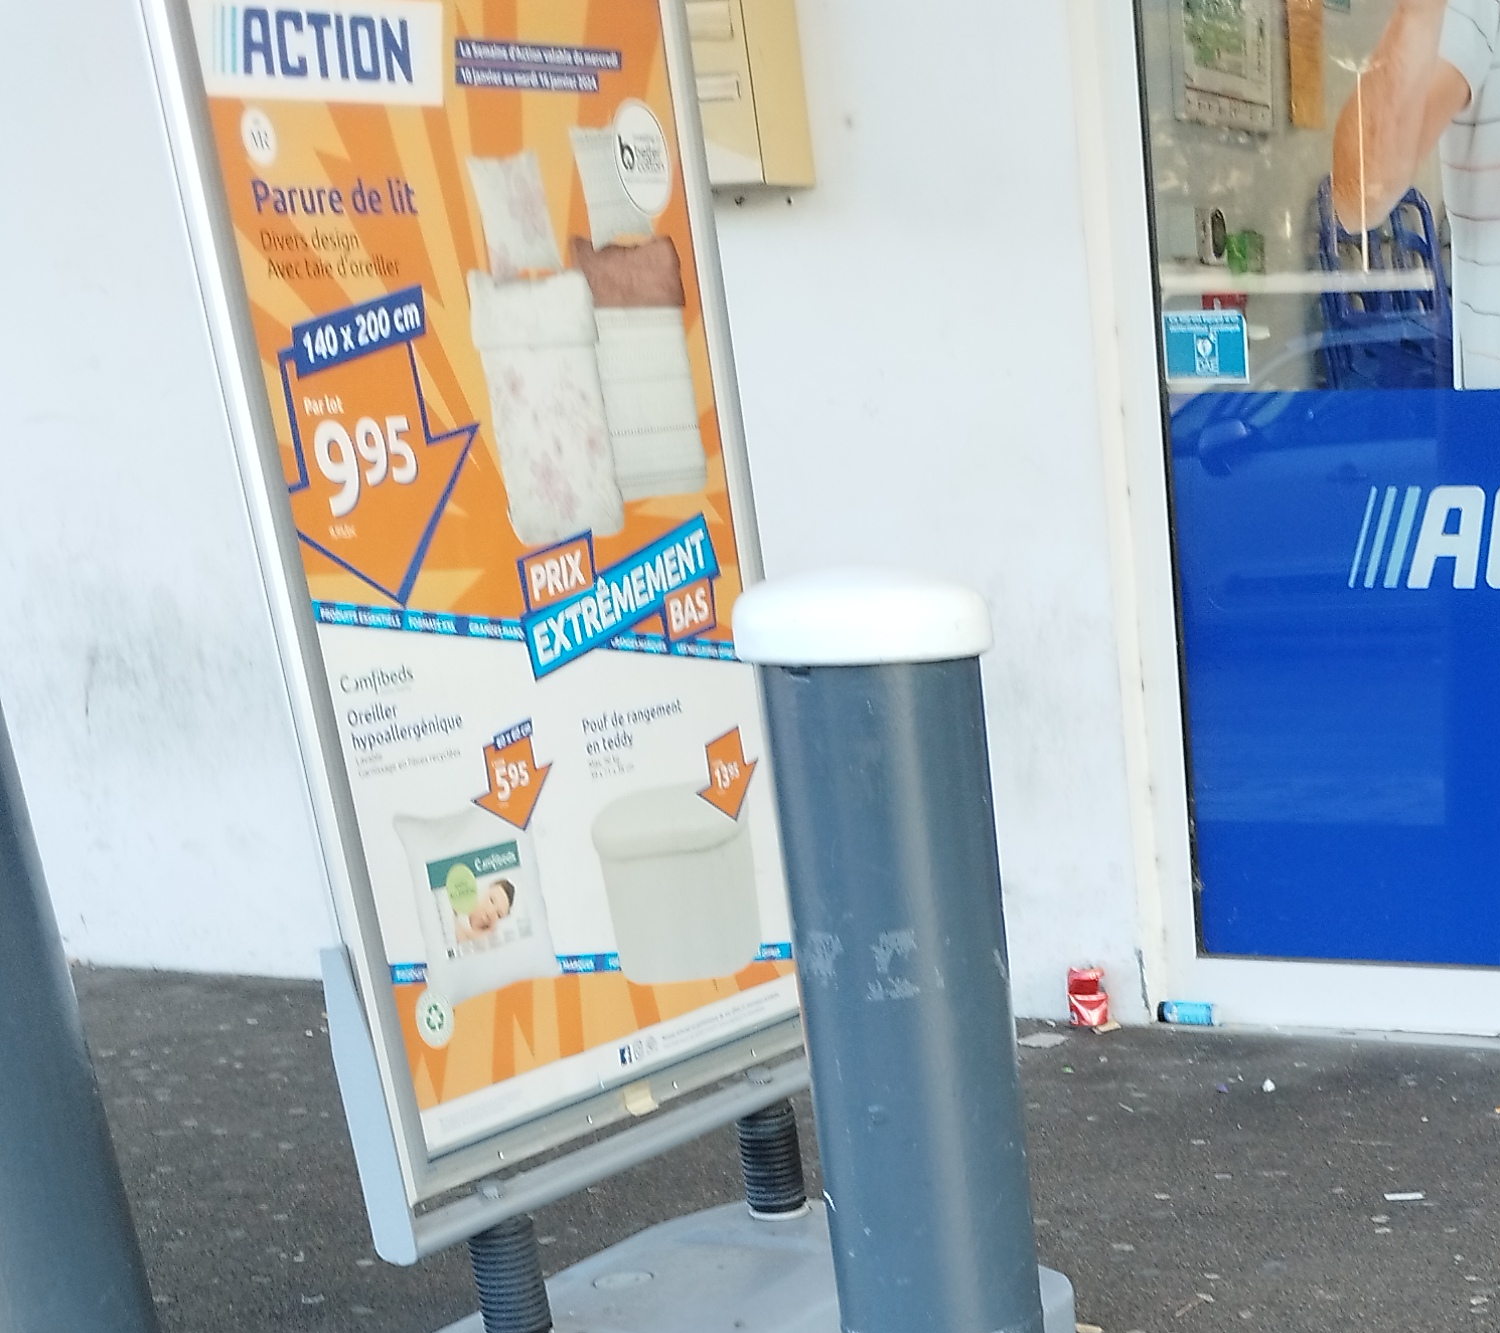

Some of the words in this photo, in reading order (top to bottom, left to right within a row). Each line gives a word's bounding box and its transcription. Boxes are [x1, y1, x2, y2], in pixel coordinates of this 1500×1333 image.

[243, 8, 414, 84] ACTION
[251, 179, 344, 215] Parure
[352, 177, 382, 216] de
[387, 177, 418, 216] lit
[260, 230, 308, 251] Divers
[312, 226, 360, 256] design
[268, 258, 301, 280] Avec
[304, 258, 333, 279] taie
[337, 253, 400, 280] d'oreiller
[302, 323, 338, 364] 140
[340, 323, 355, 352] x
[355, 306, 390, 348] 200
[393, 302, 421, 333] cm
[303, 396, 325, 417] Par
[324, 394, 345, 415] lot
[530, 549, 587, 602] PRIX
[532, 527, 705, 667] EXTRÊMEMENT
[669, 587, 710, 633] BAS
[347, 702, 397, 727] Oreiller
[351, 714, 463, 752] hypoallergénique
[581, 711, 608, 735] Pouf
[610, 709, 624, 728] de
[627, 698, 683, 724] rangement
[585, 741, 600, 756] en
[602, 729, 633, 753] teddy
